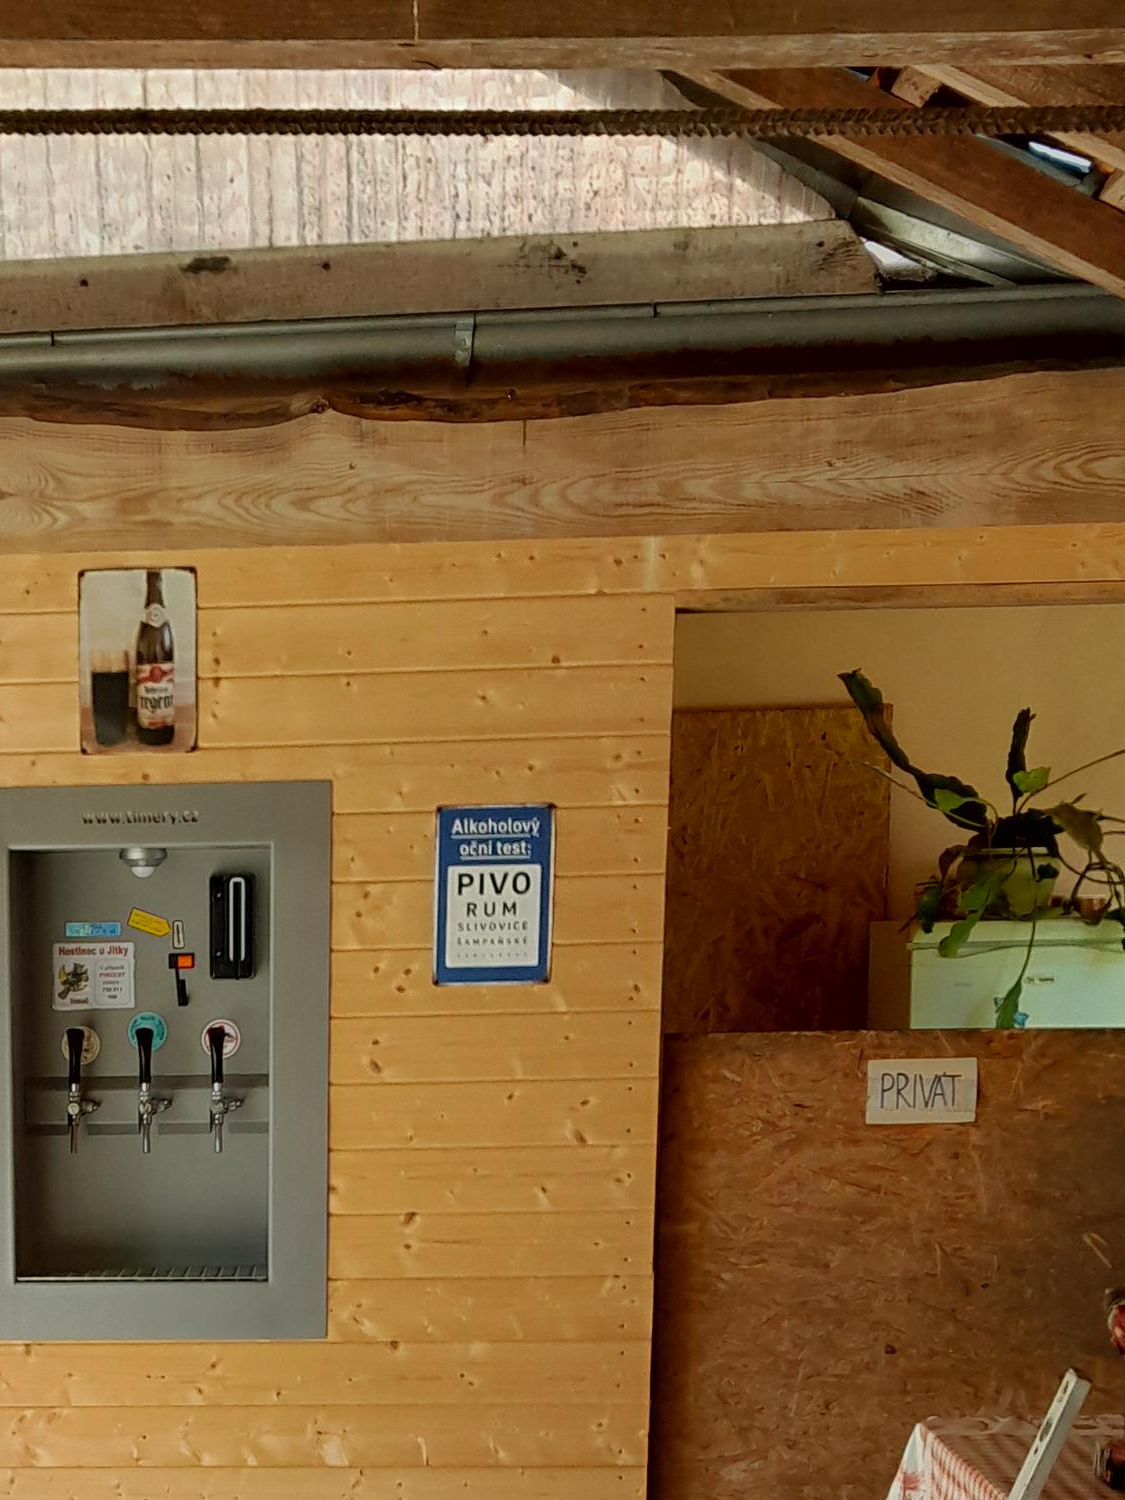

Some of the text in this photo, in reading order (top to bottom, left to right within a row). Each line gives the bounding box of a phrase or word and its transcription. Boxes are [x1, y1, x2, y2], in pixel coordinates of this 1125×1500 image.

[452, 818, 540, 837] Alkoholový
[459, 840, 493, 856] oční
[457, 872, 531, 896] PIVO
[466, 902, 517, 917] RUM
[458, 921, 528, 932] SLIVOVICE
